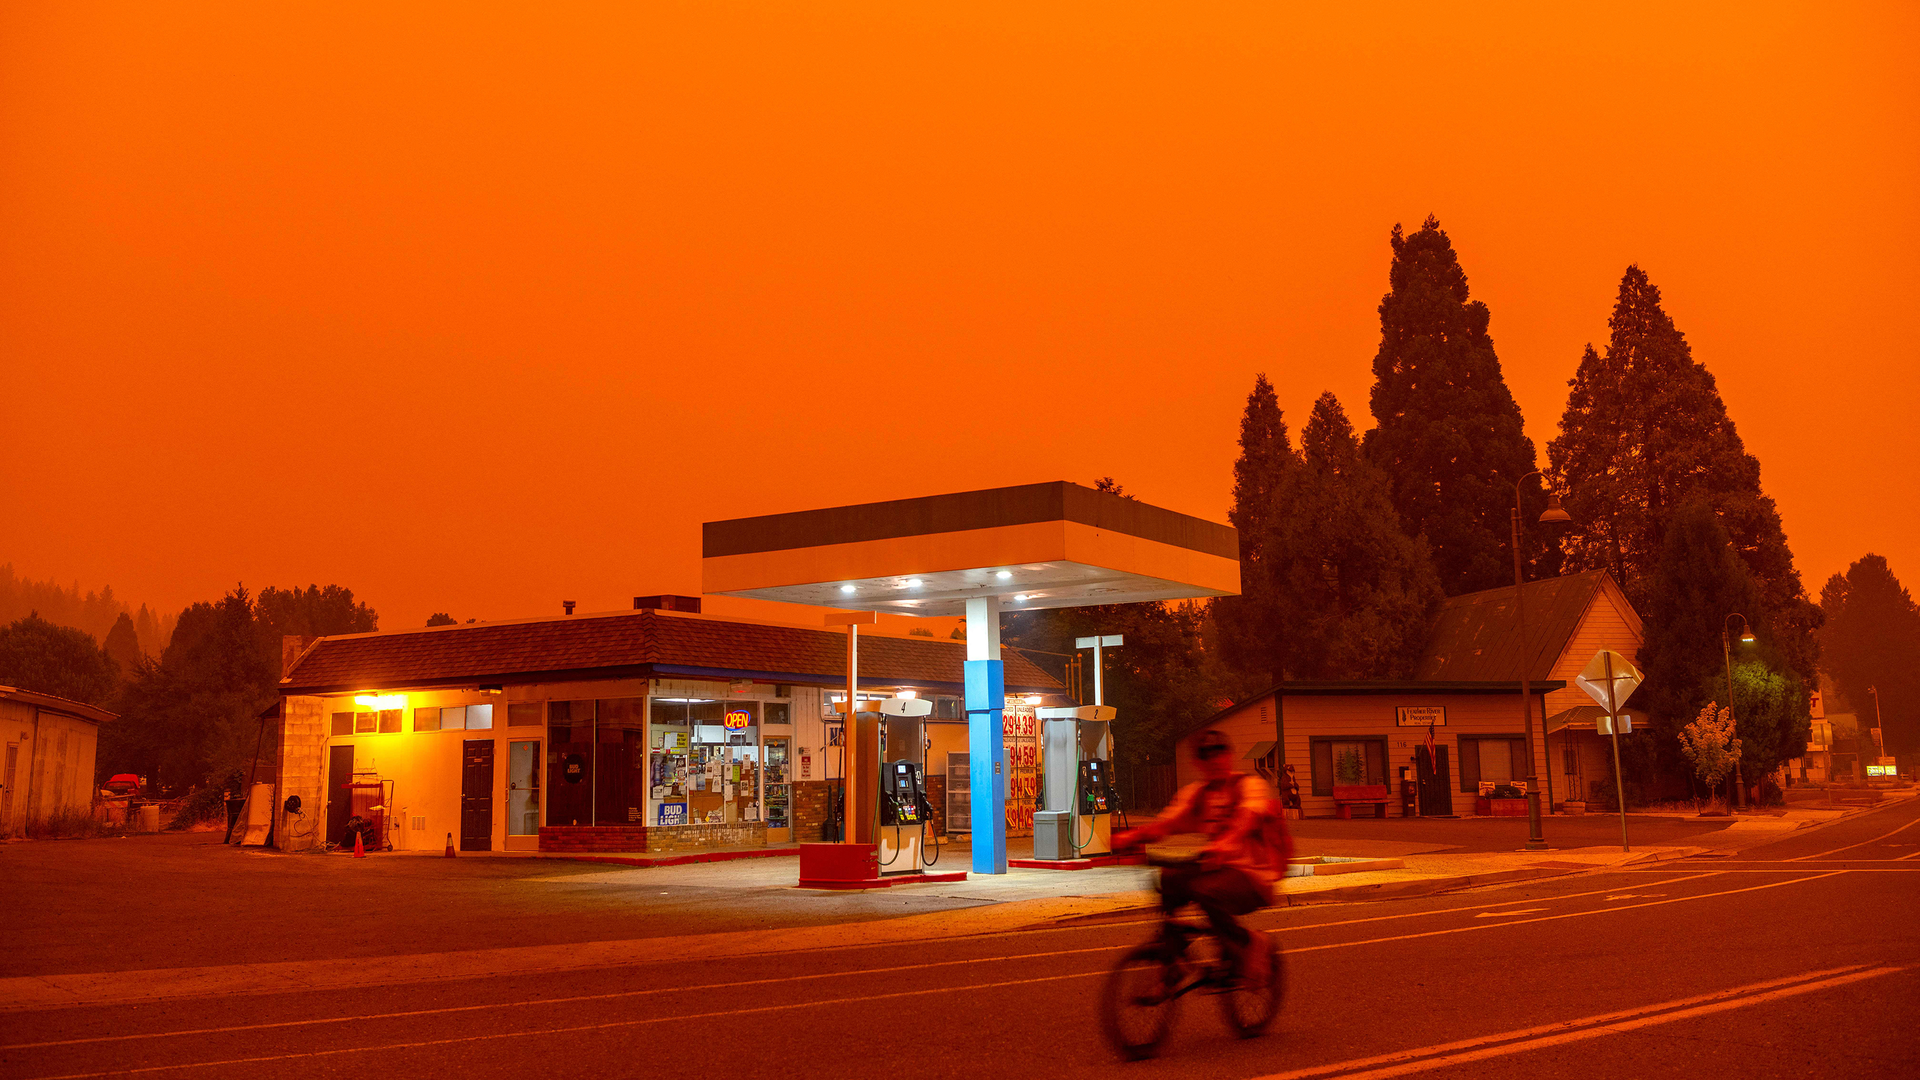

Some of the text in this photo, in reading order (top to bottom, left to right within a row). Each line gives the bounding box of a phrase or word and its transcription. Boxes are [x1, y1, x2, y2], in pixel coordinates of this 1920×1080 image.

[901, 702, 906, 713] 4
[1093, 709, 1098, 719] 2
[725, 713, 749, 728] OPEN
[664, 805, 683, 816] BUD
[660, 815, 681, 825] LIGH
